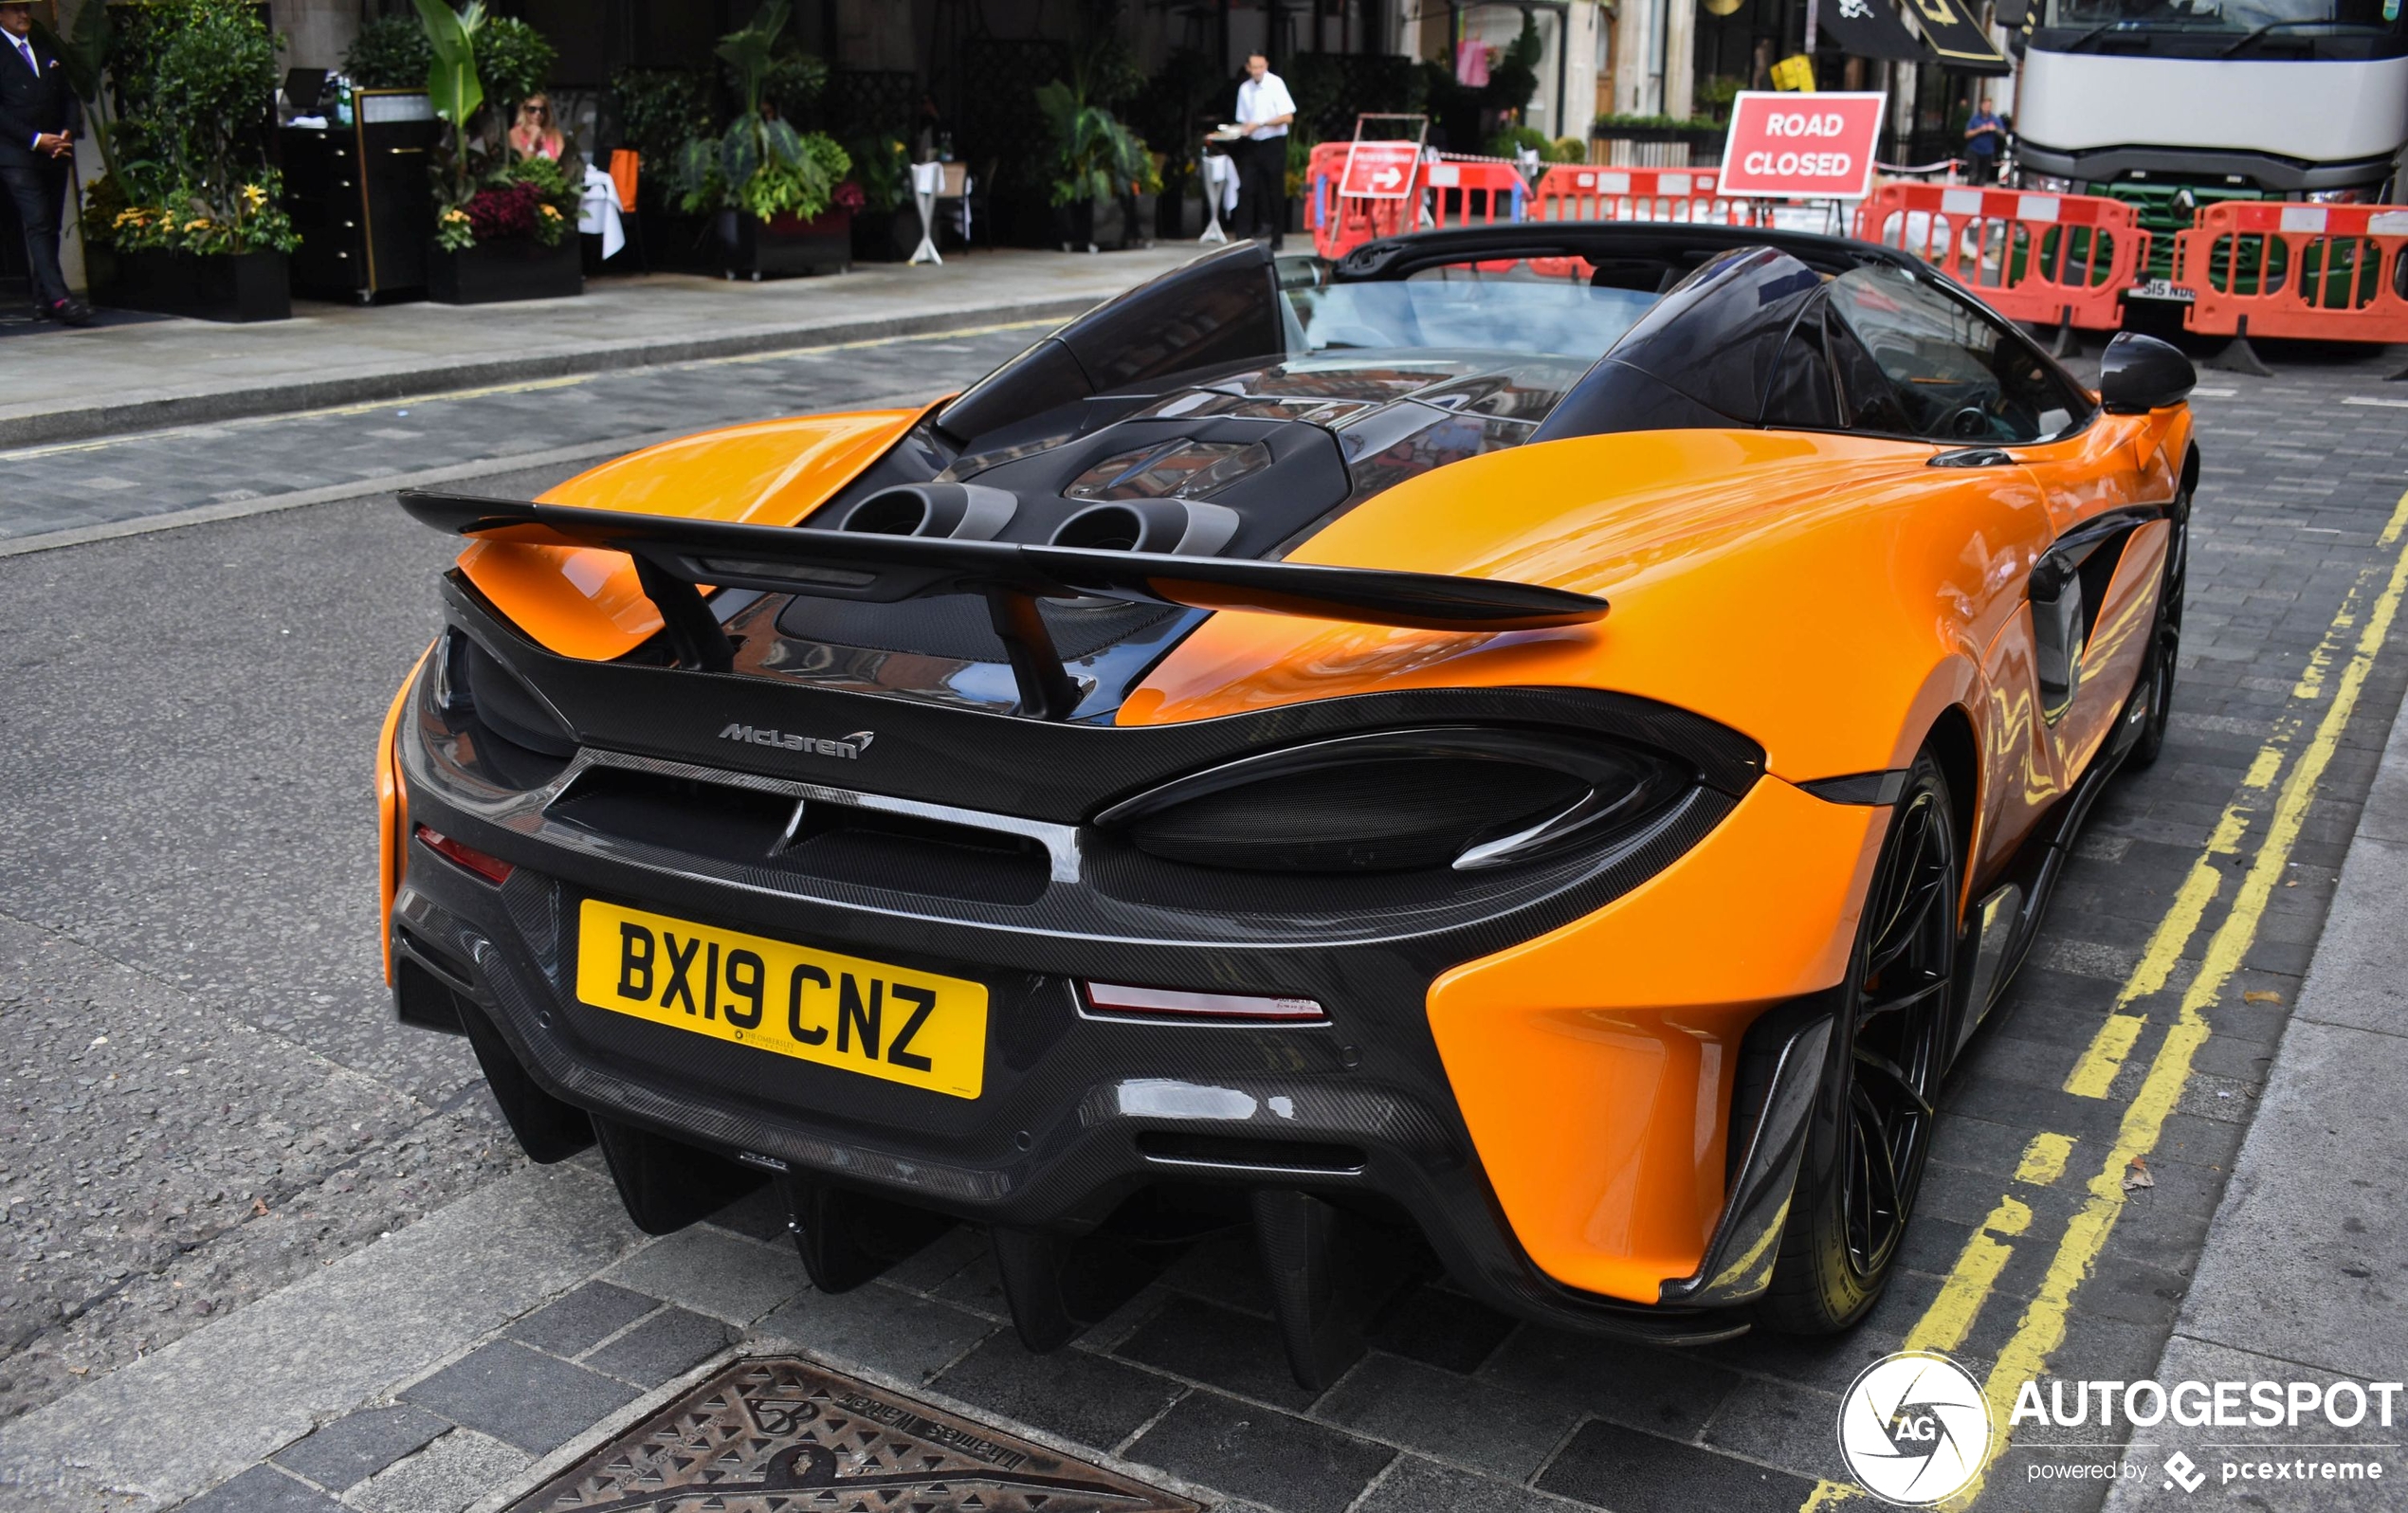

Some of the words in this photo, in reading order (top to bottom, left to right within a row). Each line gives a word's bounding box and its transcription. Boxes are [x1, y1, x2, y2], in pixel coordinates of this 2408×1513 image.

[1765, 113, 1844, 137] ROAD
[1743, 151, 1852, 176] CLOSED
[719, 723, 857, 759] McLaren
[617, 921, 765, 1030] BX19
[788, 964, 938, 1073] CNZ
[745, 1031, 757, 1040] THE
[757, 1034, 794, 1049] OMBERSLEY
[837, 1393, 918, 1431] Water
[927, 1424, 1027, 1470] Thames
